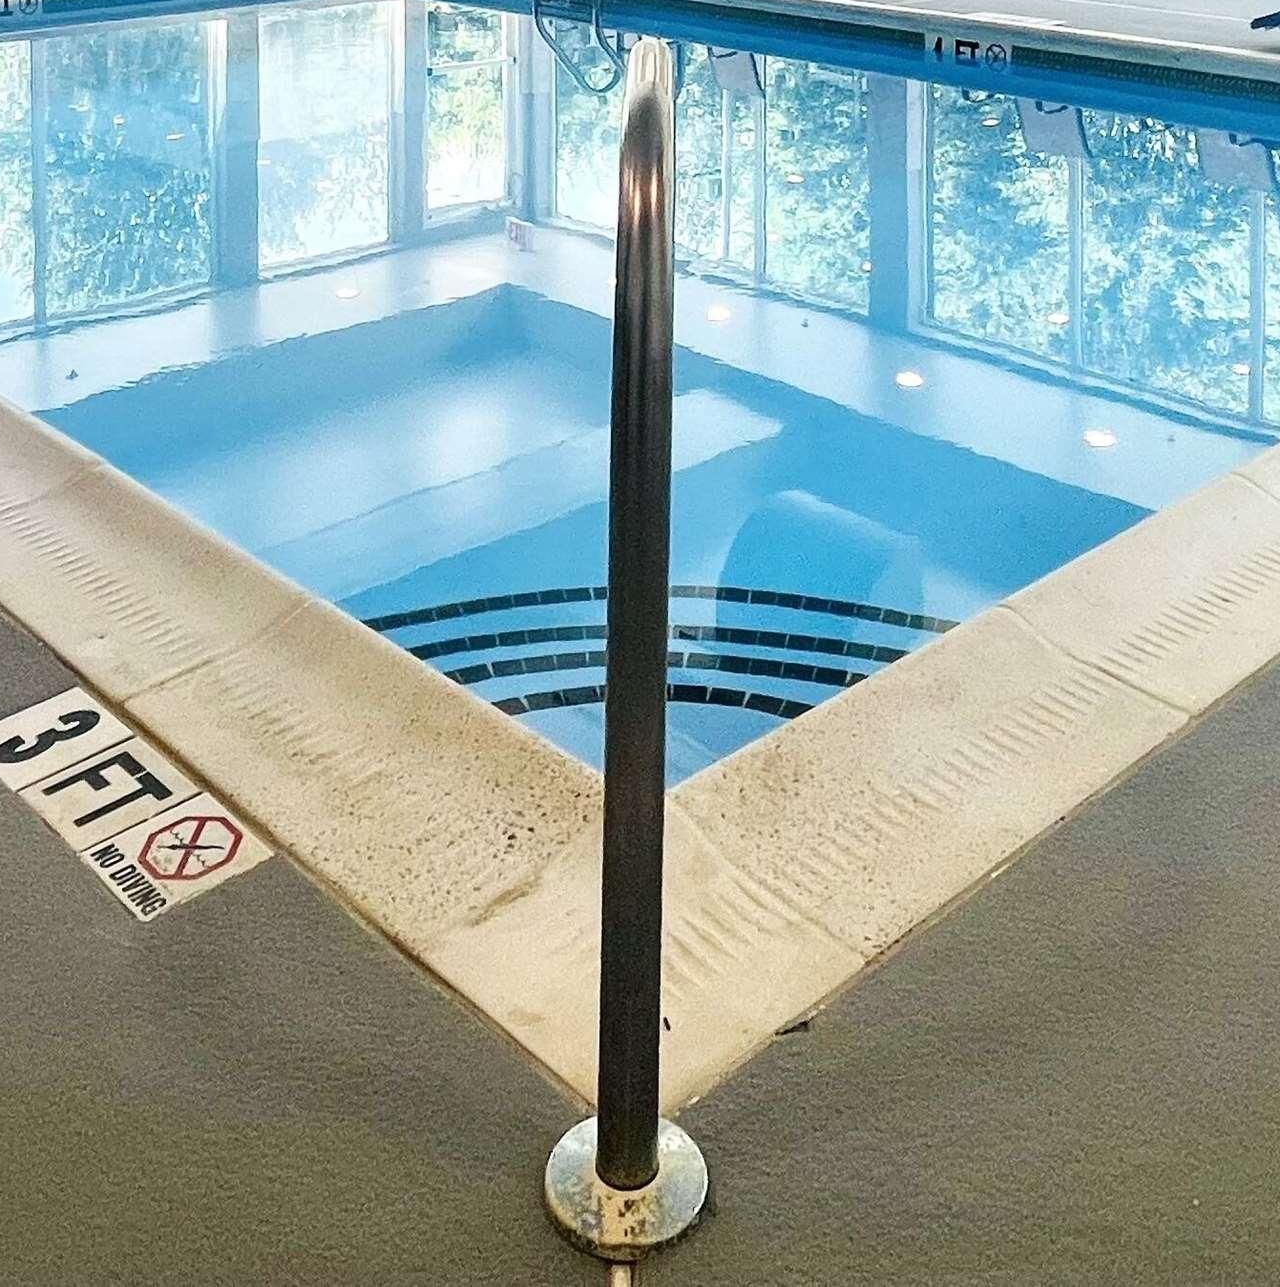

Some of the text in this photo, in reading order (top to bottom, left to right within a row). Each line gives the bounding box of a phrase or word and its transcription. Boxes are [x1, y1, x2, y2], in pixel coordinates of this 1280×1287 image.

[42, 751, 173, 828] FT
[90, 843, 166, 916] NO DIVING
